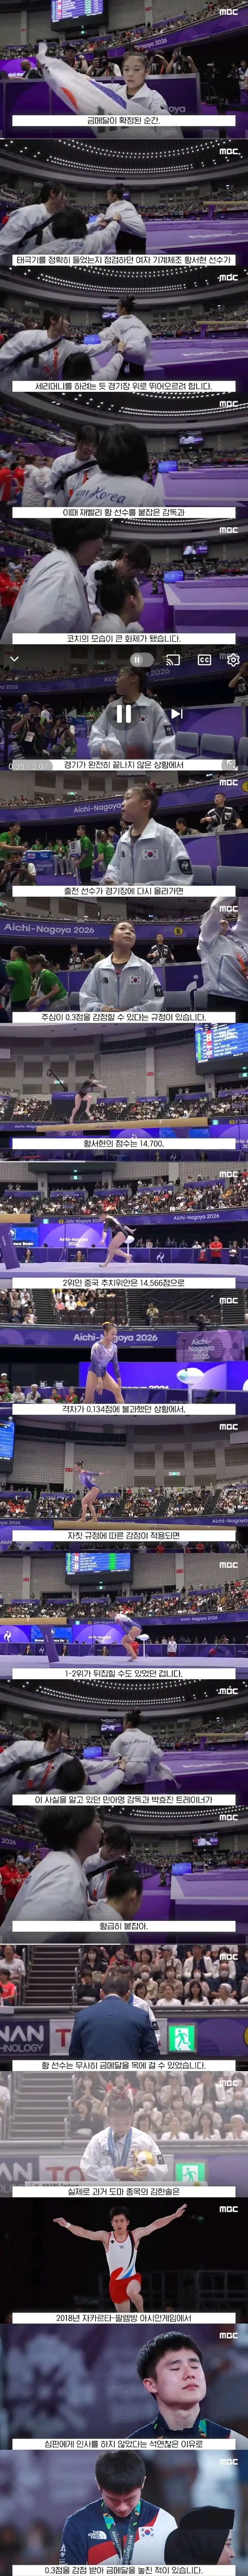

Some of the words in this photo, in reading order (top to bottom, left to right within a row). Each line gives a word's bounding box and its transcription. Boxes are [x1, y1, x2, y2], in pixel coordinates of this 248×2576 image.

[89, 486, 126, 505] Korea
[151, 668, 170, 676] 2026
[74, 803, 121, 813] Aichi-Nagoya
[4, 923, 71, 935] Aichi-Nagoya
